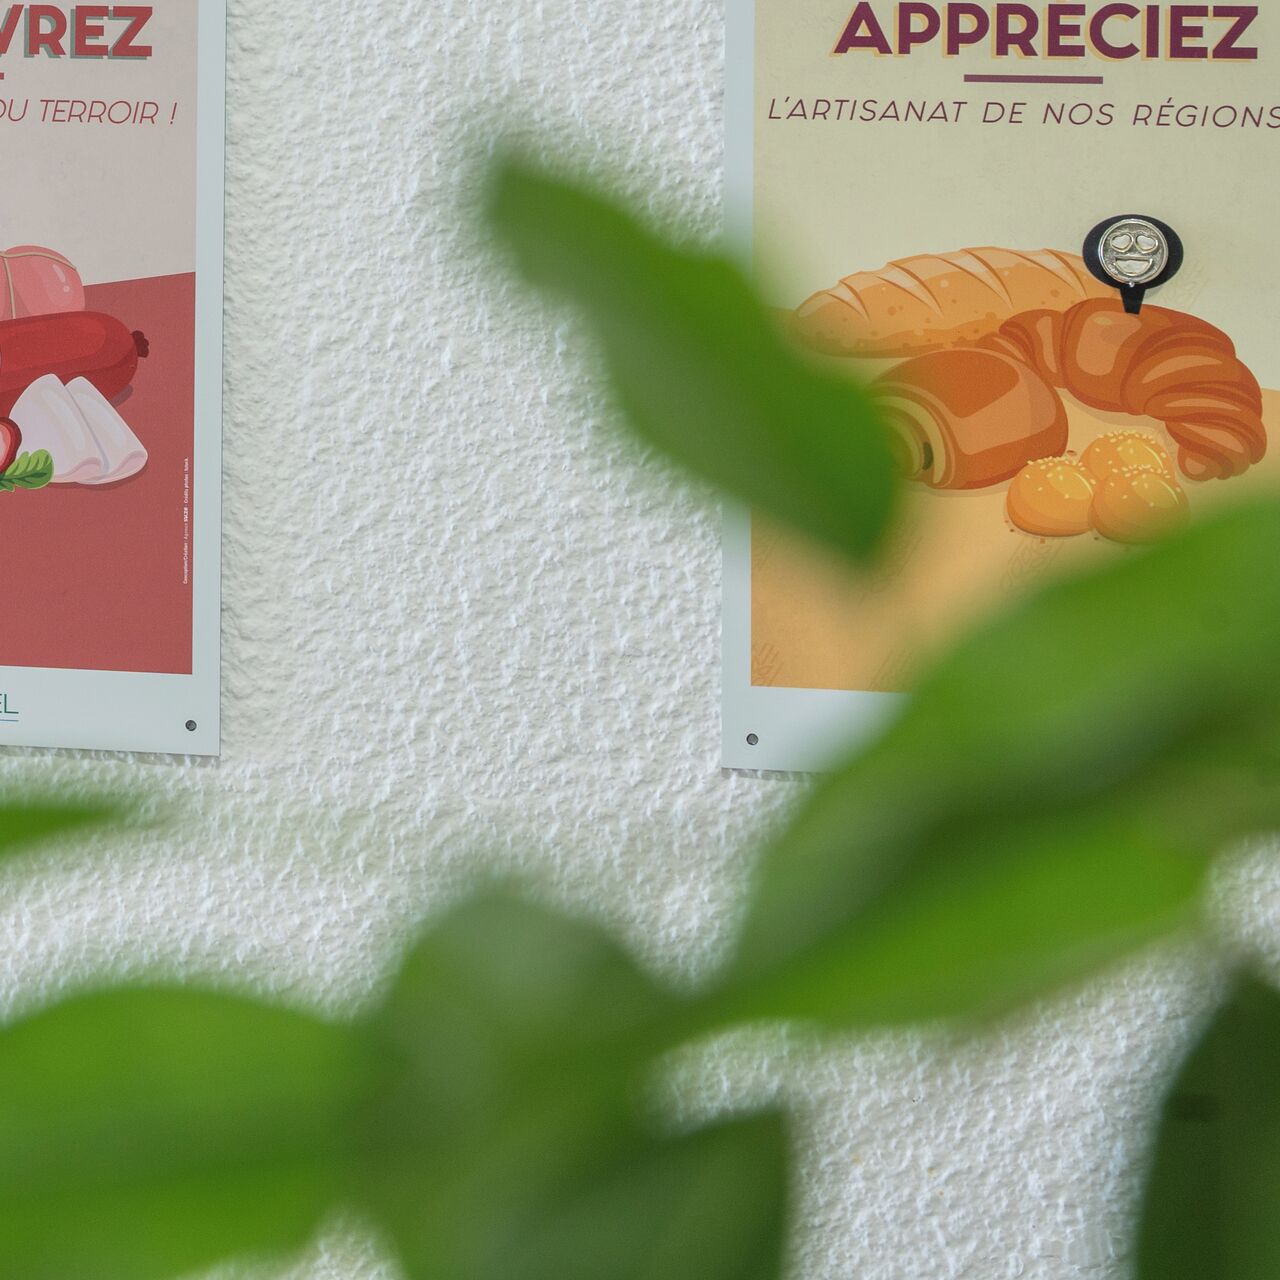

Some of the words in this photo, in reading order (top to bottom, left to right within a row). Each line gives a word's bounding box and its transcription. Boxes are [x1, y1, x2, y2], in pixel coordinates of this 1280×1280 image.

[39, 99, 160, 125] TERROIR
[169, 101, 178, 125] !
[768, 96, 968, 122] L'ARTISANAT
[982, 101, 1027, 124] DE
[1042, 102, 1115, 127] NOS
[1132, 97, 1280, 129] RÉGIONS
